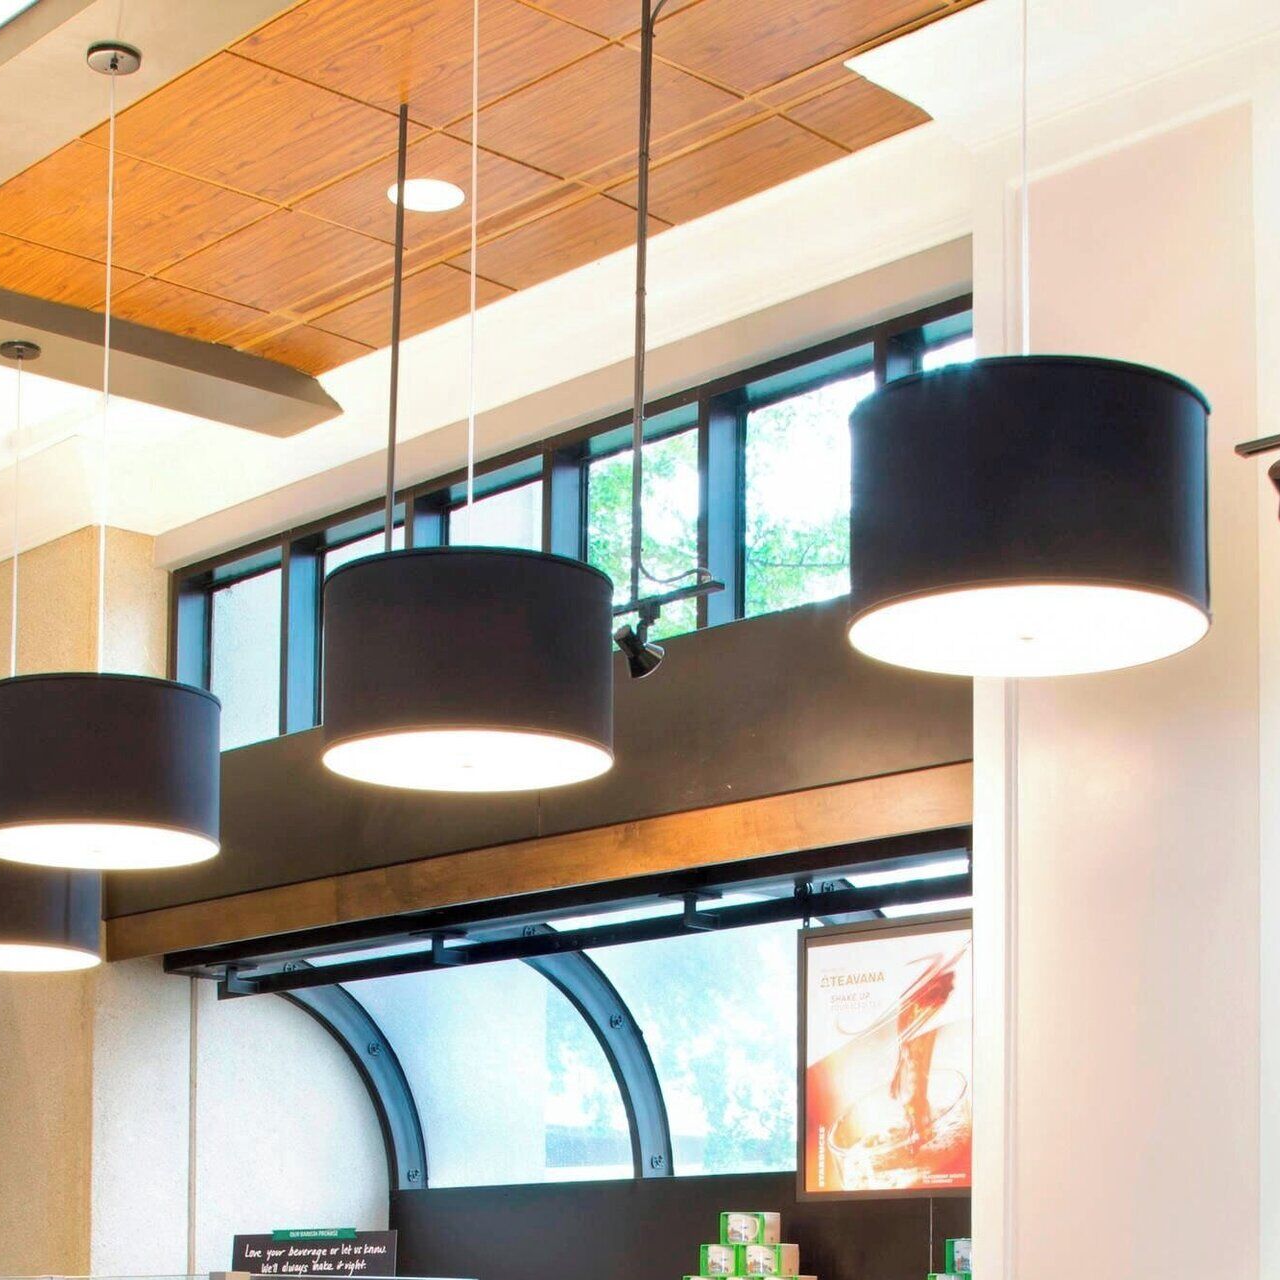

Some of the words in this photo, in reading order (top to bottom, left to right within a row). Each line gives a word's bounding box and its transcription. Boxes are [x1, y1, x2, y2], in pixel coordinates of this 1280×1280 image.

[245, 1244, 262, 1258] Love
[267, 1249, 286, 1261] your
[288, 1246, 327, 1262] beverage
[330, 1247, 340, 1256] or
[341, 1243, 351, 1255] let
[282, 1262, 309, 1275] always
[312, 1260, 333, 1271] make
